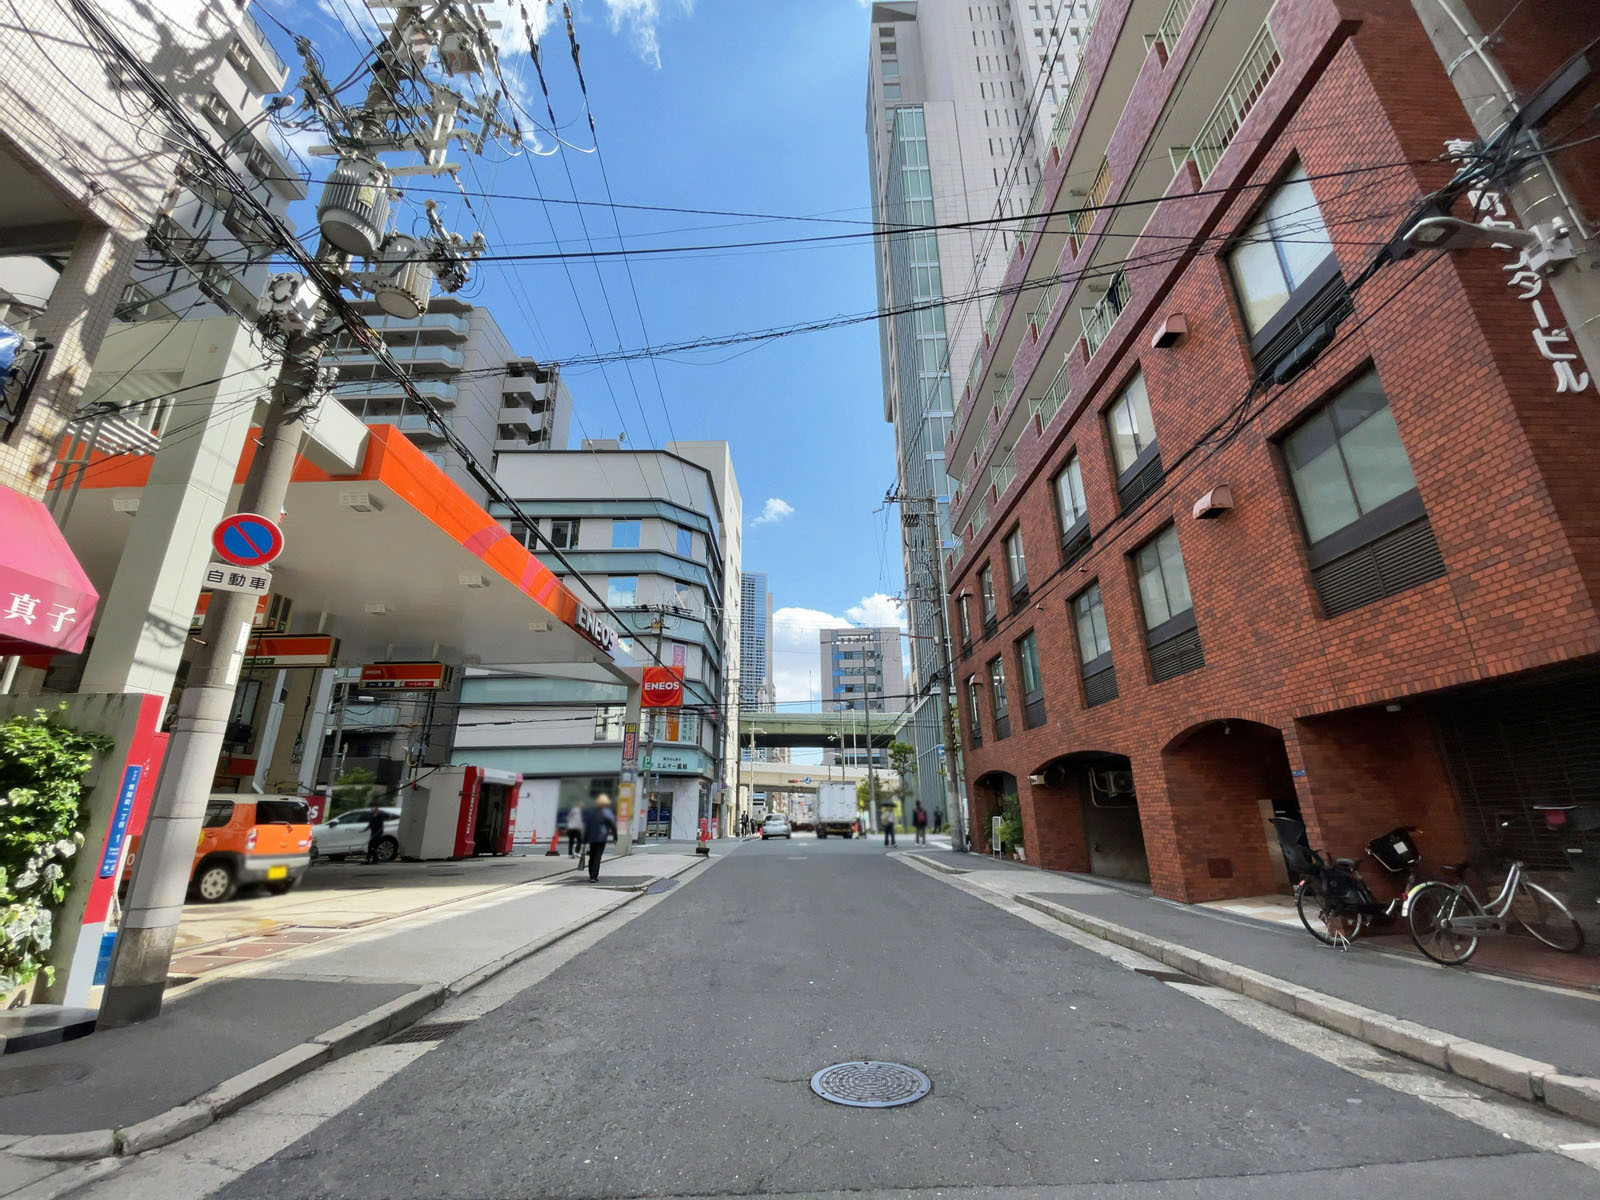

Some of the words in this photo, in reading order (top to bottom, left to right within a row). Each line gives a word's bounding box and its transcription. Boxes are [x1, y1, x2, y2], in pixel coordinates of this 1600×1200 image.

[207, 569, 267, 590] 自動車
[3, 592, 77, 633] 真子
[576, 602, 619, 652] ENEOS
[644, 681, 680, 692] ENEOS
